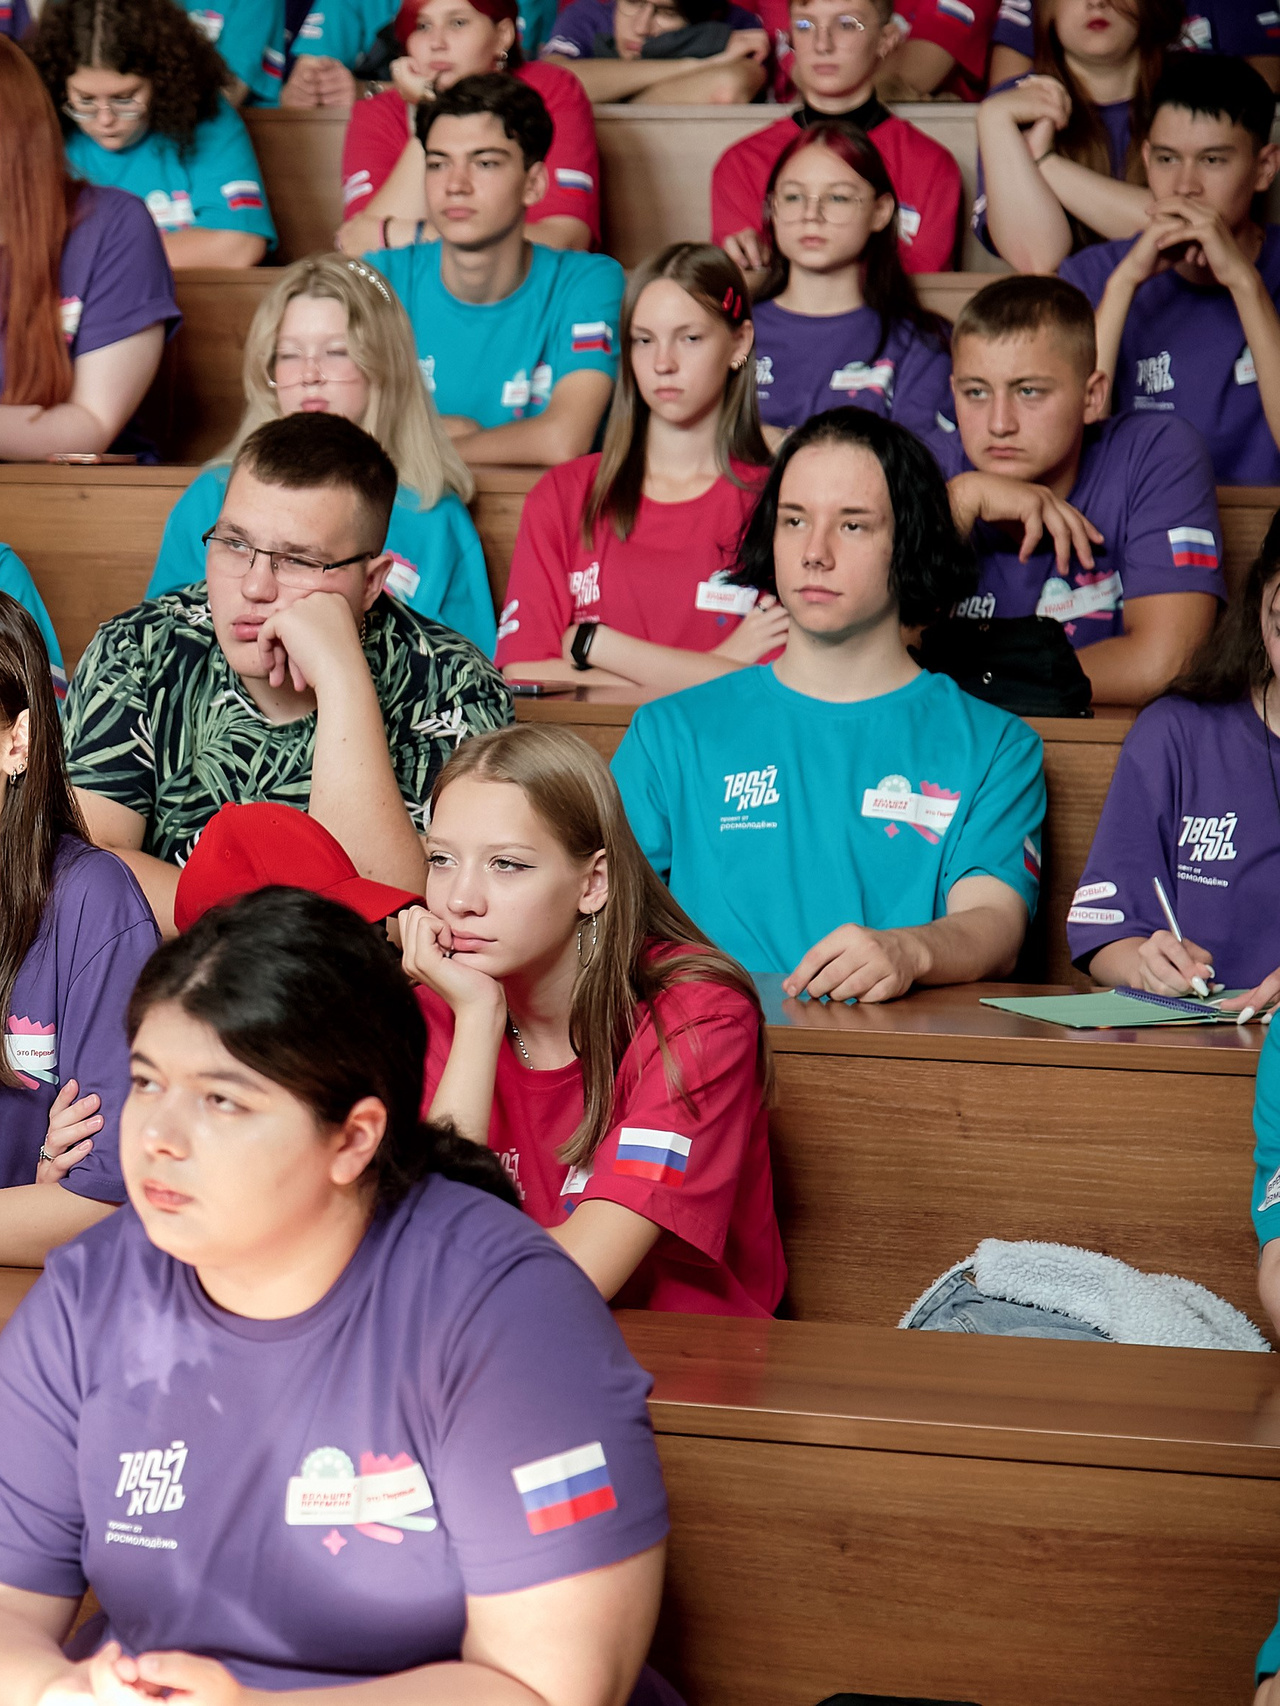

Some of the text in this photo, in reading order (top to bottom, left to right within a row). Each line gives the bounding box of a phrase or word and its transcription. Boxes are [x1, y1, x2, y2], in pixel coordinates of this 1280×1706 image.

[723, 764, 778, 804] ТВОЙ
[1178, 812, 1238, 847] ТВОЙ
[115, 1440, 189, 1498] ТВОЙ
[126, 1483, 186, 1517] ХОД
[105, 1531, 179, 1550] росмолодёжь
